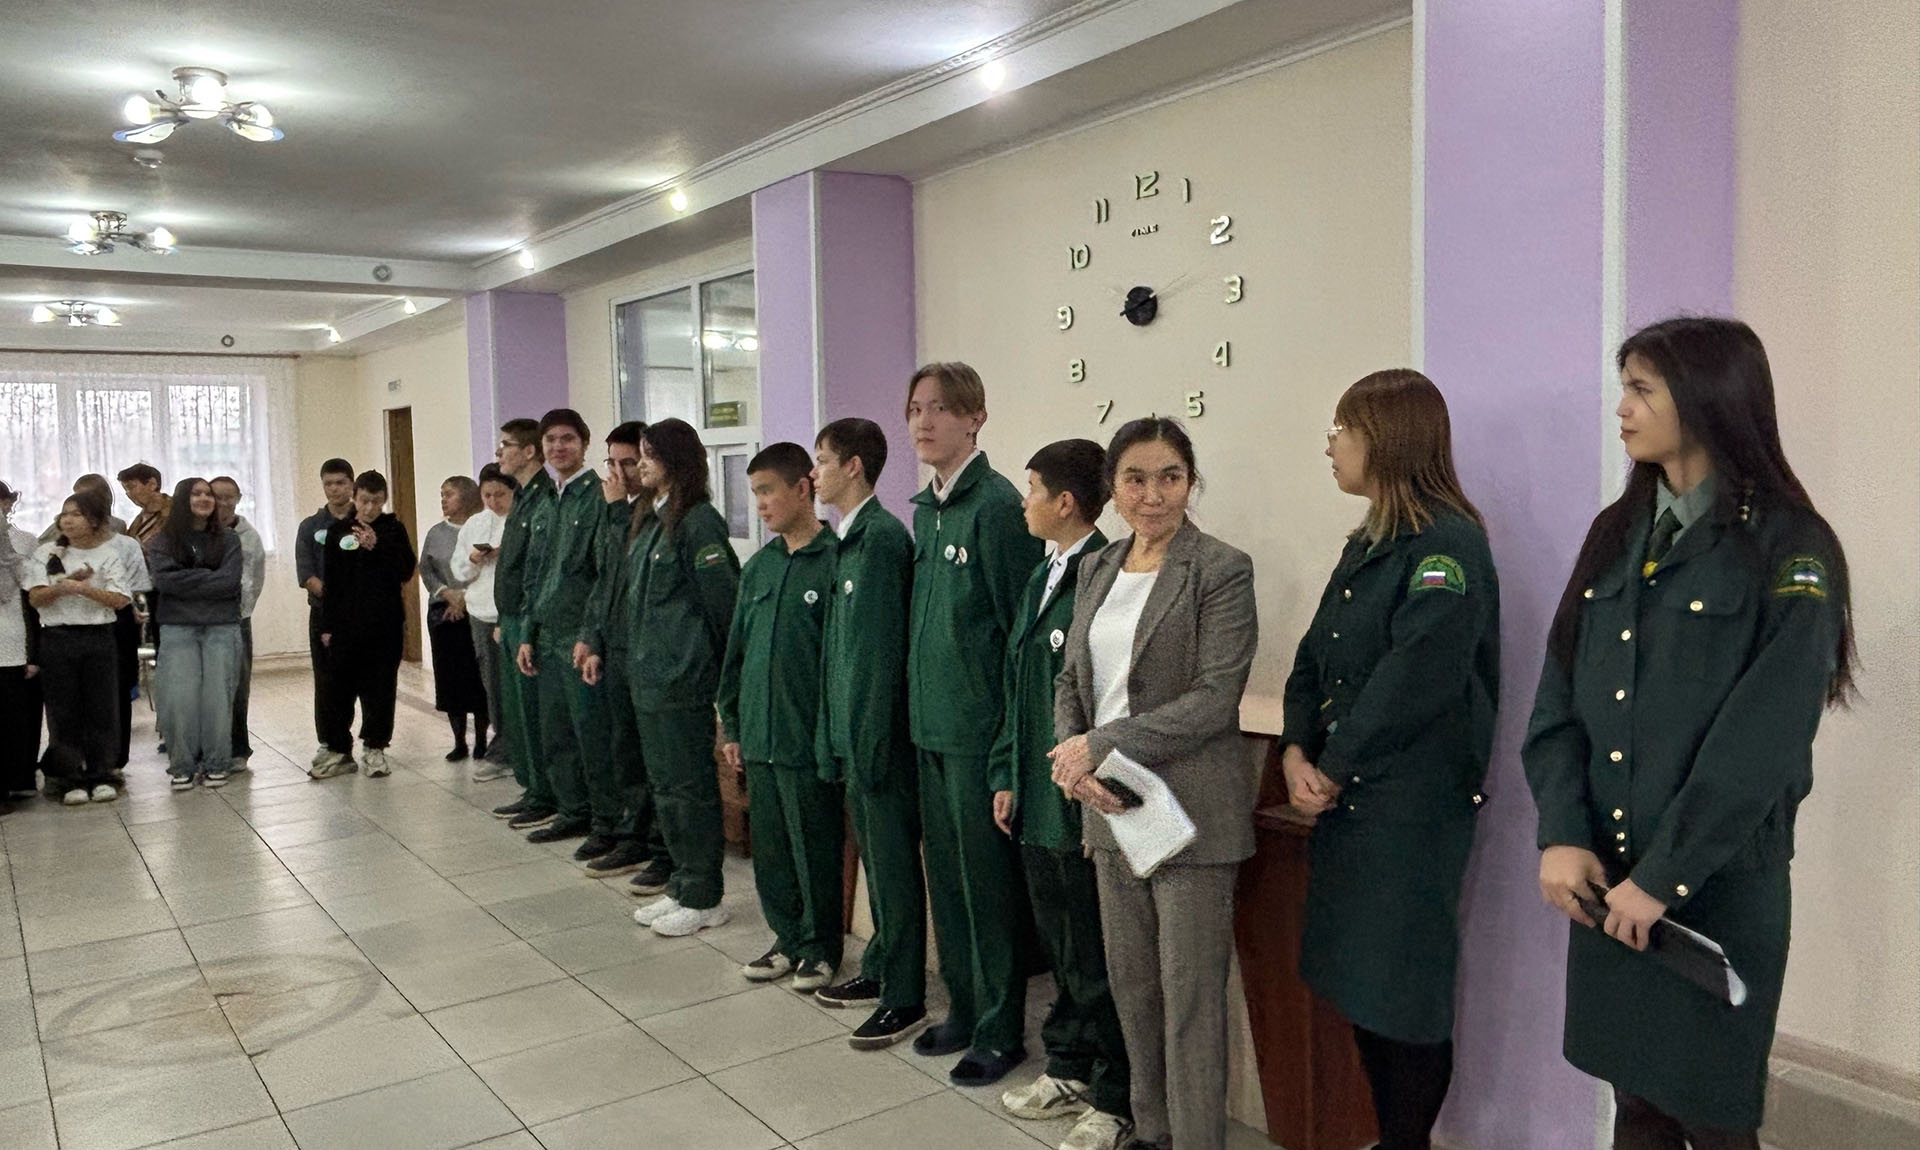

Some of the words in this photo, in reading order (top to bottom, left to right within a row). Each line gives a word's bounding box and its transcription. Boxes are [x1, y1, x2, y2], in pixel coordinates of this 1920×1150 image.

[1135, 171, 1159, 200] 12
[1182, 178, 1191, 203] 1
[1095, 198, 1109, 224] 11
[1210, 216, 1232, 245] 2
[1069, 244, 1090, 270] 10
[1225, 275, 1243, 304] 3
[1057, 306, 1074, 331] 9
[1212, 341, 1230, 367] 4
[1069, 359, 1085, 382] 8
[1096, 400, 1113, 424] 7
[1186, 391, 1204, 417] 5
